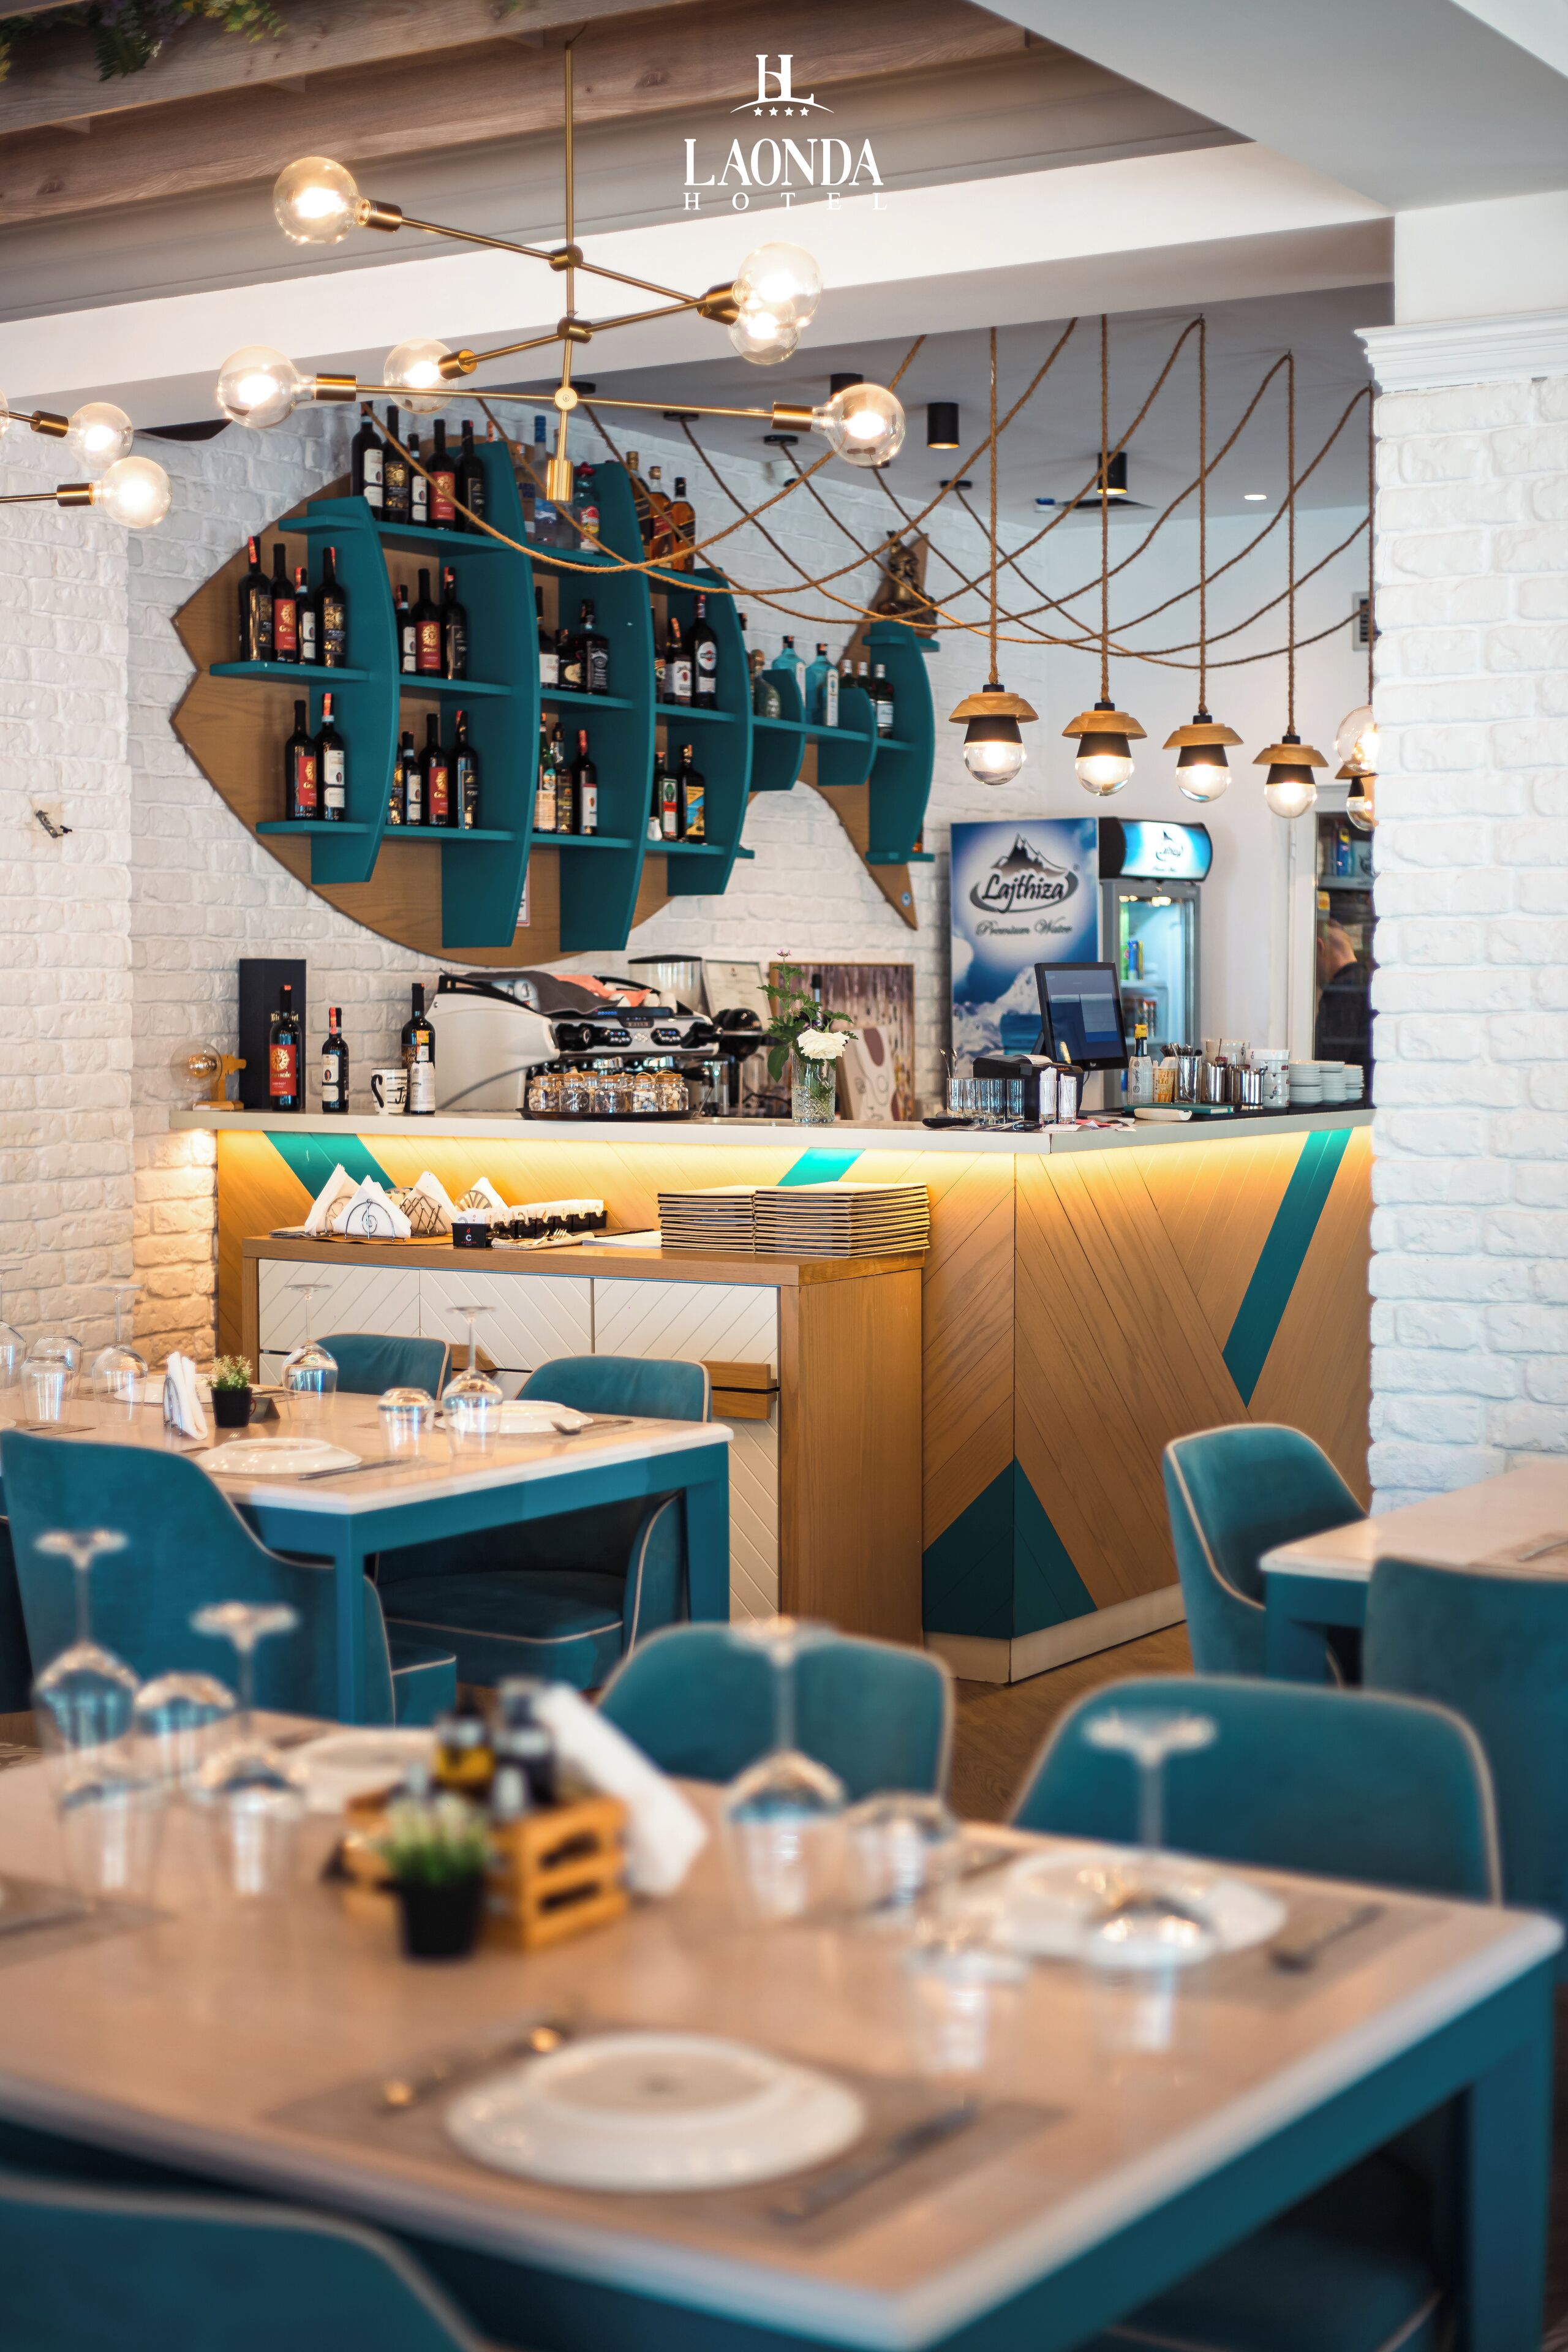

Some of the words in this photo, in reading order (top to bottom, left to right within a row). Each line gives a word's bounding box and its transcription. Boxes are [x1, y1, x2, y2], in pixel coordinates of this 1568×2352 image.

[981, 873, 1065, 913] Lajthiza
[976, 919, 1030, 937] Premium
[1034, 917, 1073, 935] Water
